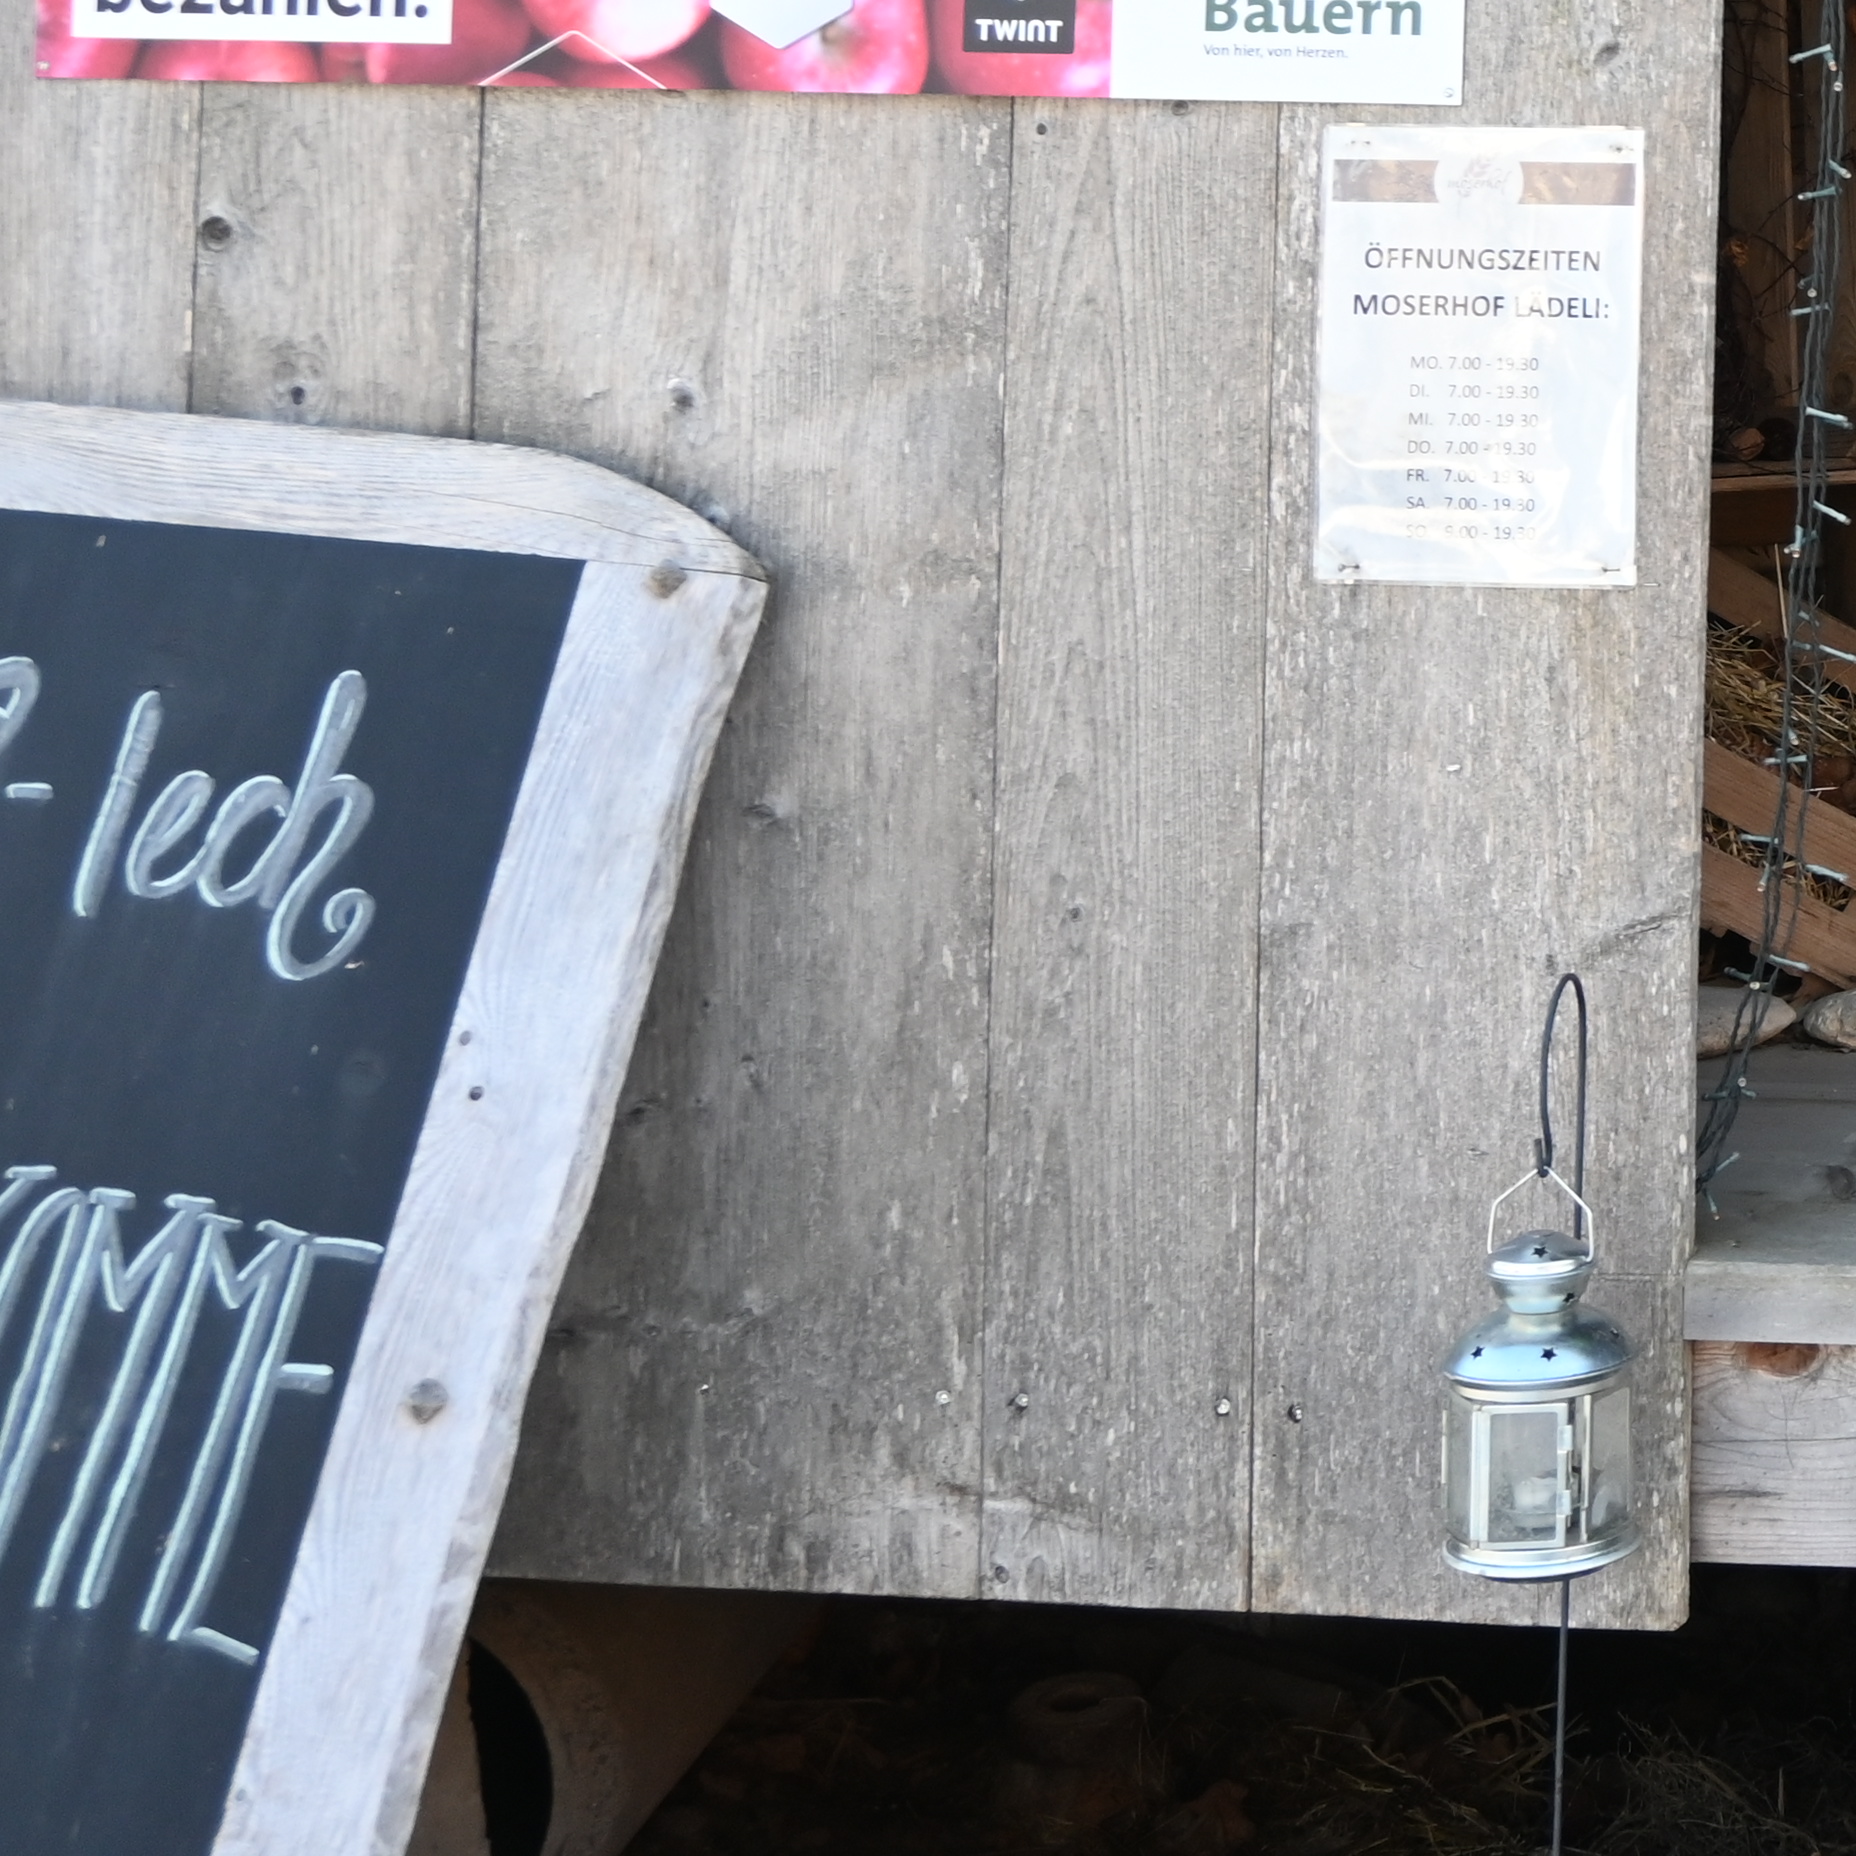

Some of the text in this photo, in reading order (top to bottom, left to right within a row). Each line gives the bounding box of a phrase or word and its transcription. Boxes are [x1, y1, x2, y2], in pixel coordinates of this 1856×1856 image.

[975, 17, 1064, 44] TWINT
[1203, 44, 1349, 59] Von hier, von Herzen.
[1364, 242, 1602, 272] ÖFFNUNGSZEITEN
[1353, 291, 1610, 319] MOSERHOF LÄDELI:
[1410, 355, 1443, 370] MO.
[1448, 356, 1481, 370] 7.00
[1409, 383, 1430, 398] DI.
[1448, 384, 1481, 398] 7.00
[1408, 412, 1433, 426] MI.
[1448, 412, 1480, 426] 7.00
[1407, 440, 1435, 454] DO.
[1445, 441, 1478, 455] 7.00
[1406, 468, 1429, 482] FR.
[1444, 497, 1477, 511] 7.00
